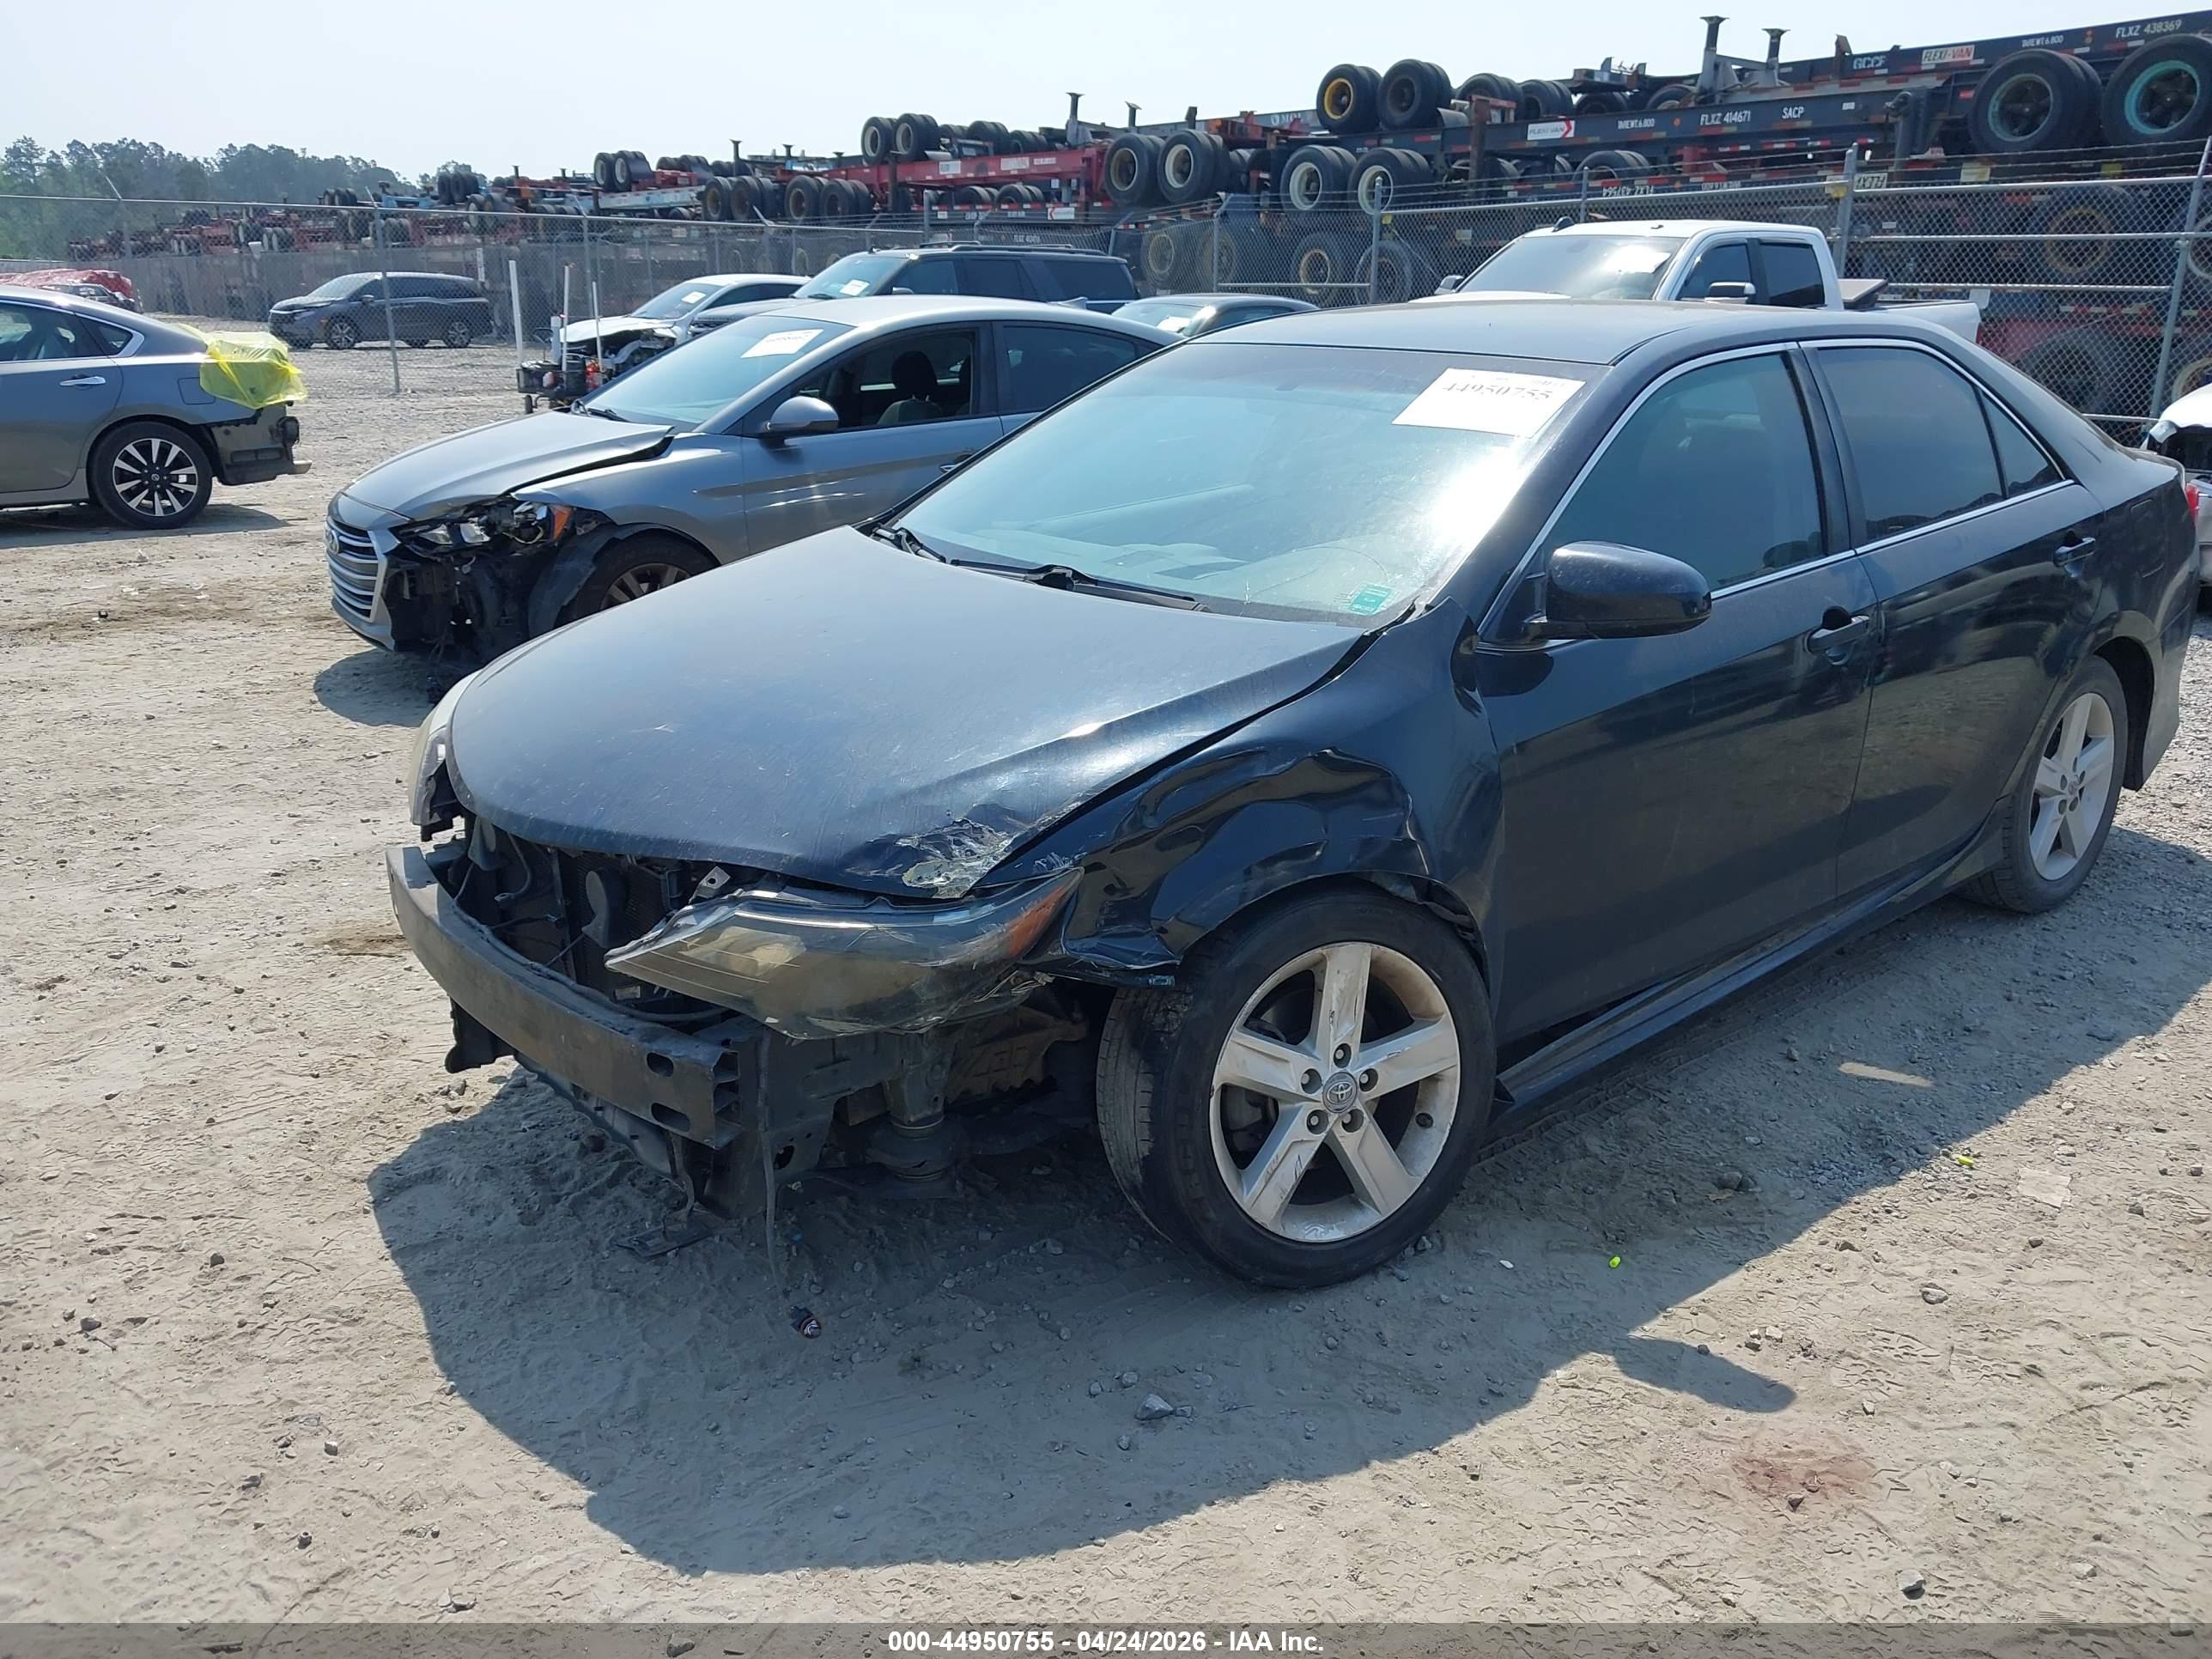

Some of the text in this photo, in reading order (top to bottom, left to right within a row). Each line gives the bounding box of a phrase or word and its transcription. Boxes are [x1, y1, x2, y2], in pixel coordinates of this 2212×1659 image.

[2116, 19, 2182, 39] FLXZ 438369
[1923, 46, 1972, 63] FLEXI-VAN
[1700, 110, 1751, 125] FLXZ 414671
[1782, 106, 1804, 118] SACP
